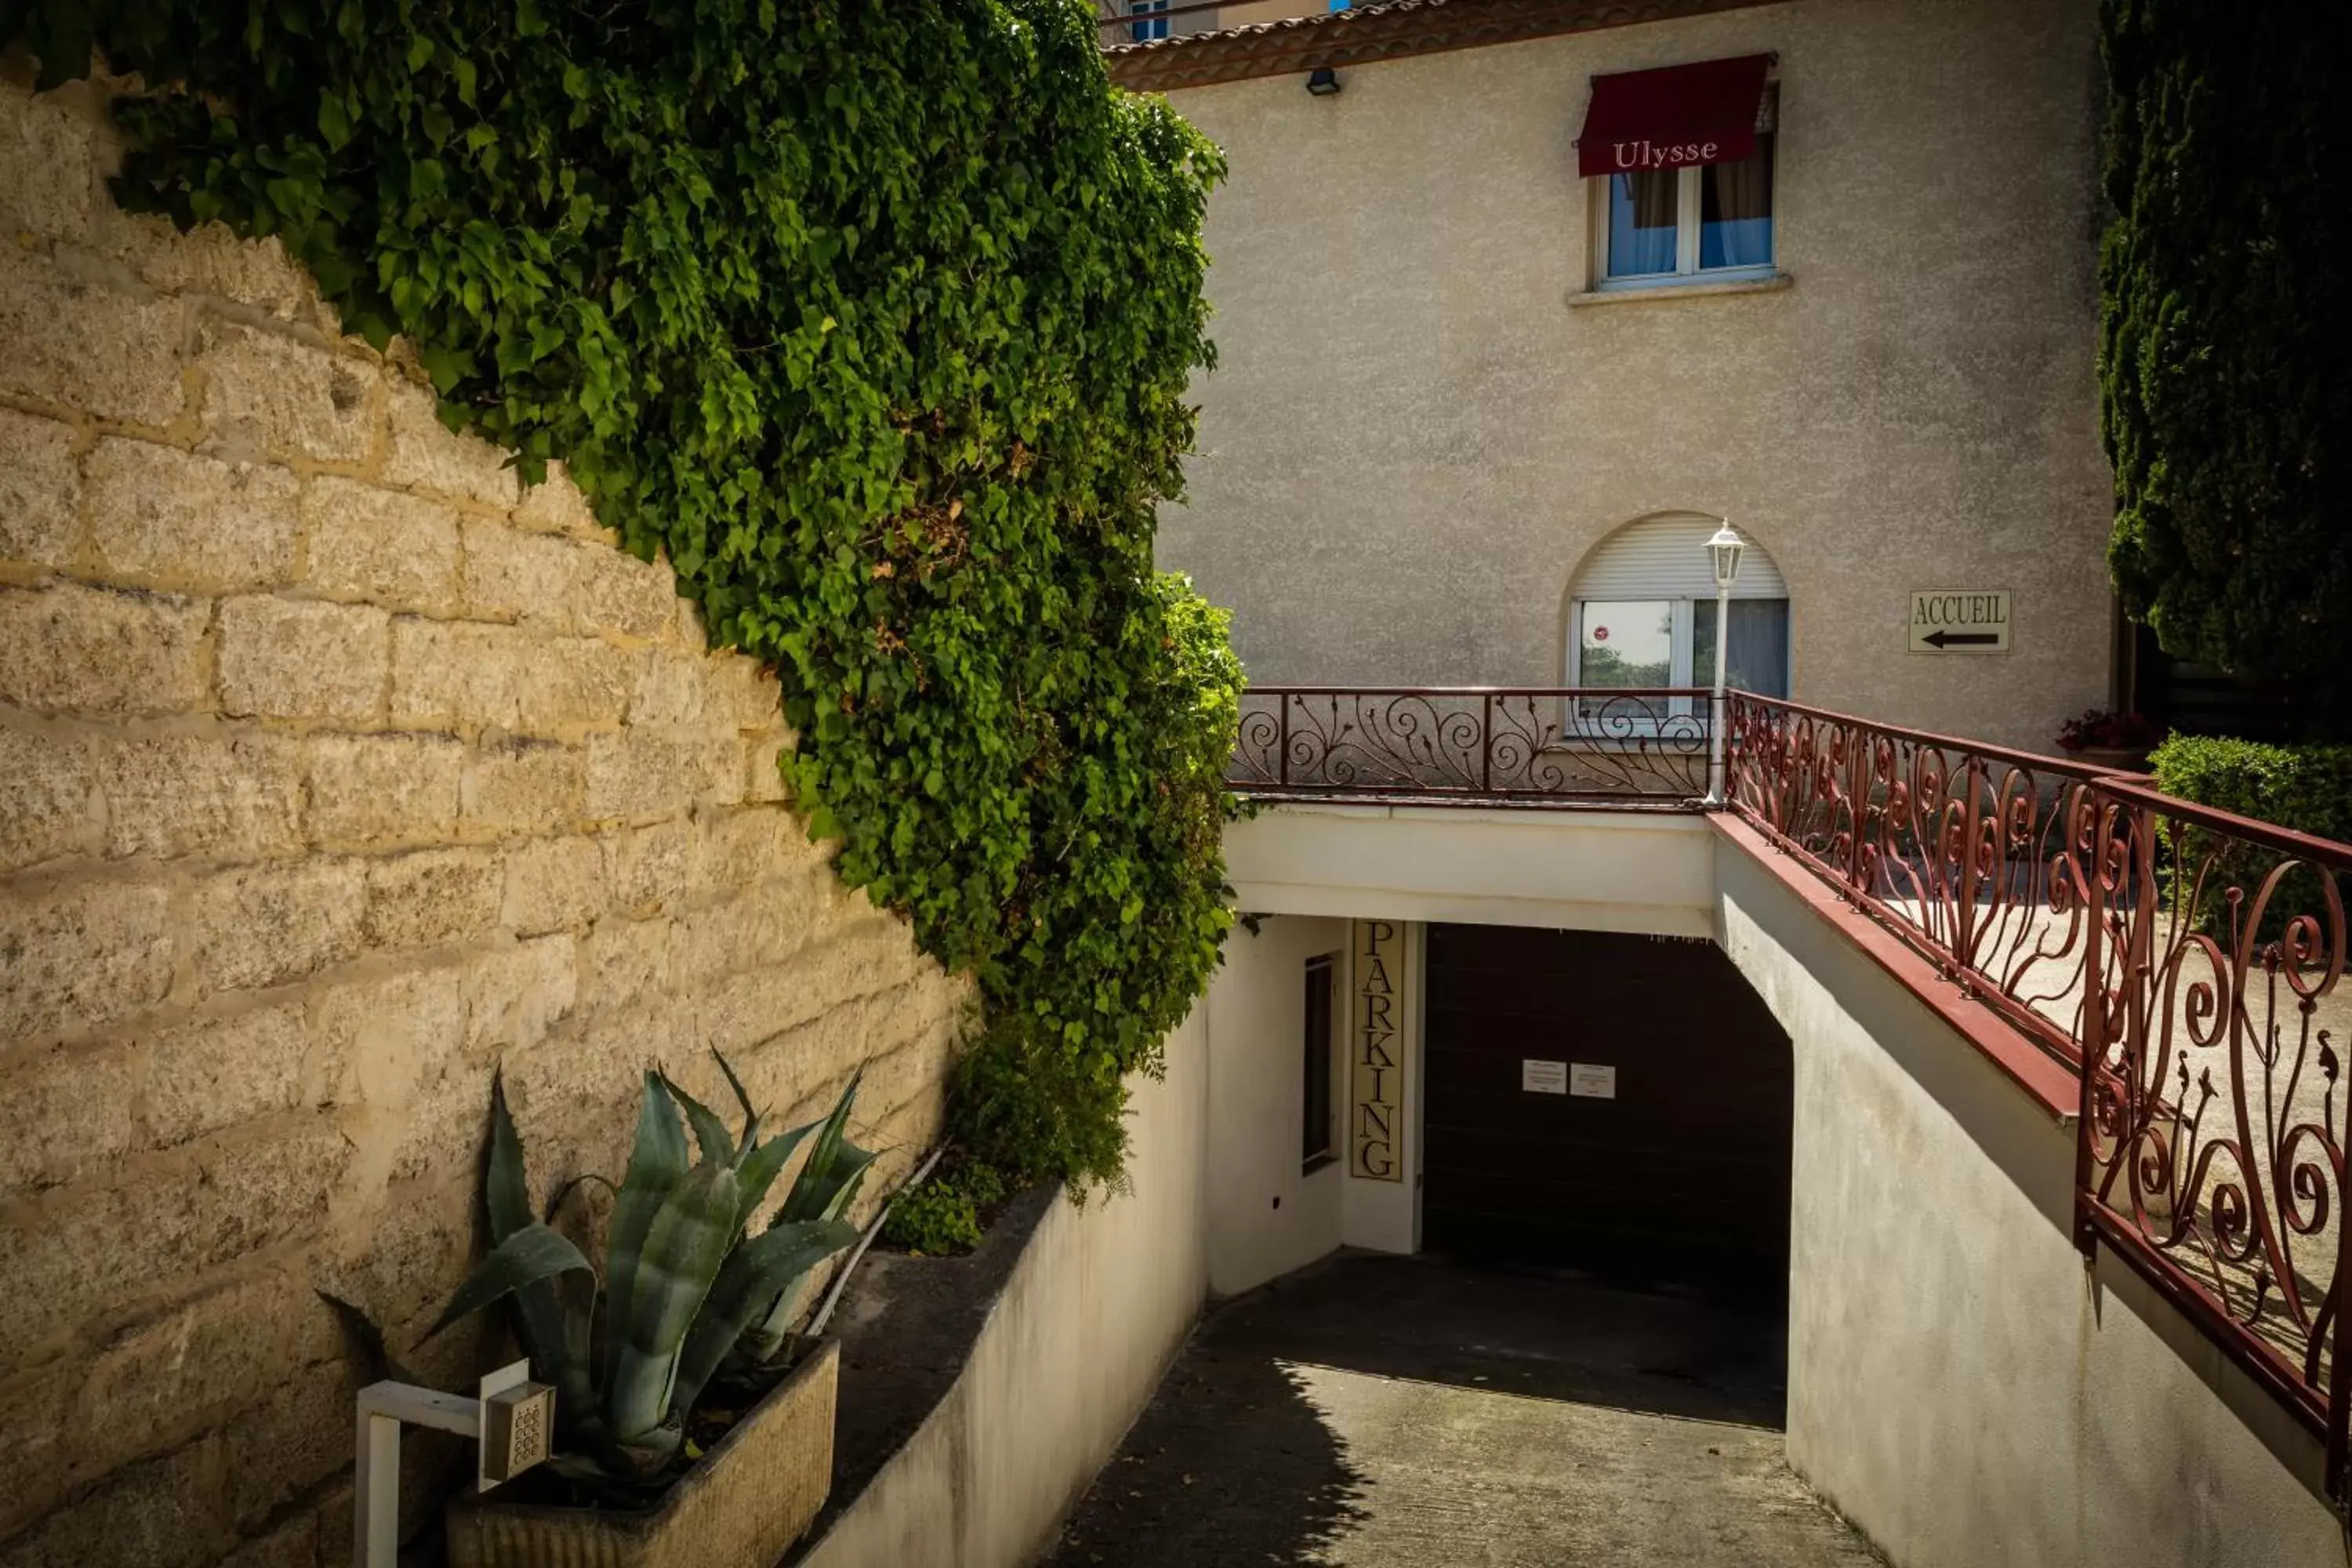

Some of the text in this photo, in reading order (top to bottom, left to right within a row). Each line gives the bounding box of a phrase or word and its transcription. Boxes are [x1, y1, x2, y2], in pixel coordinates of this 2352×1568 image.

[1613, 140, 1719, 169] Ulysse
[1914, 595, 2006, 625] ACCUEIL
[1359, 921, 1396, 1176] PARKING
